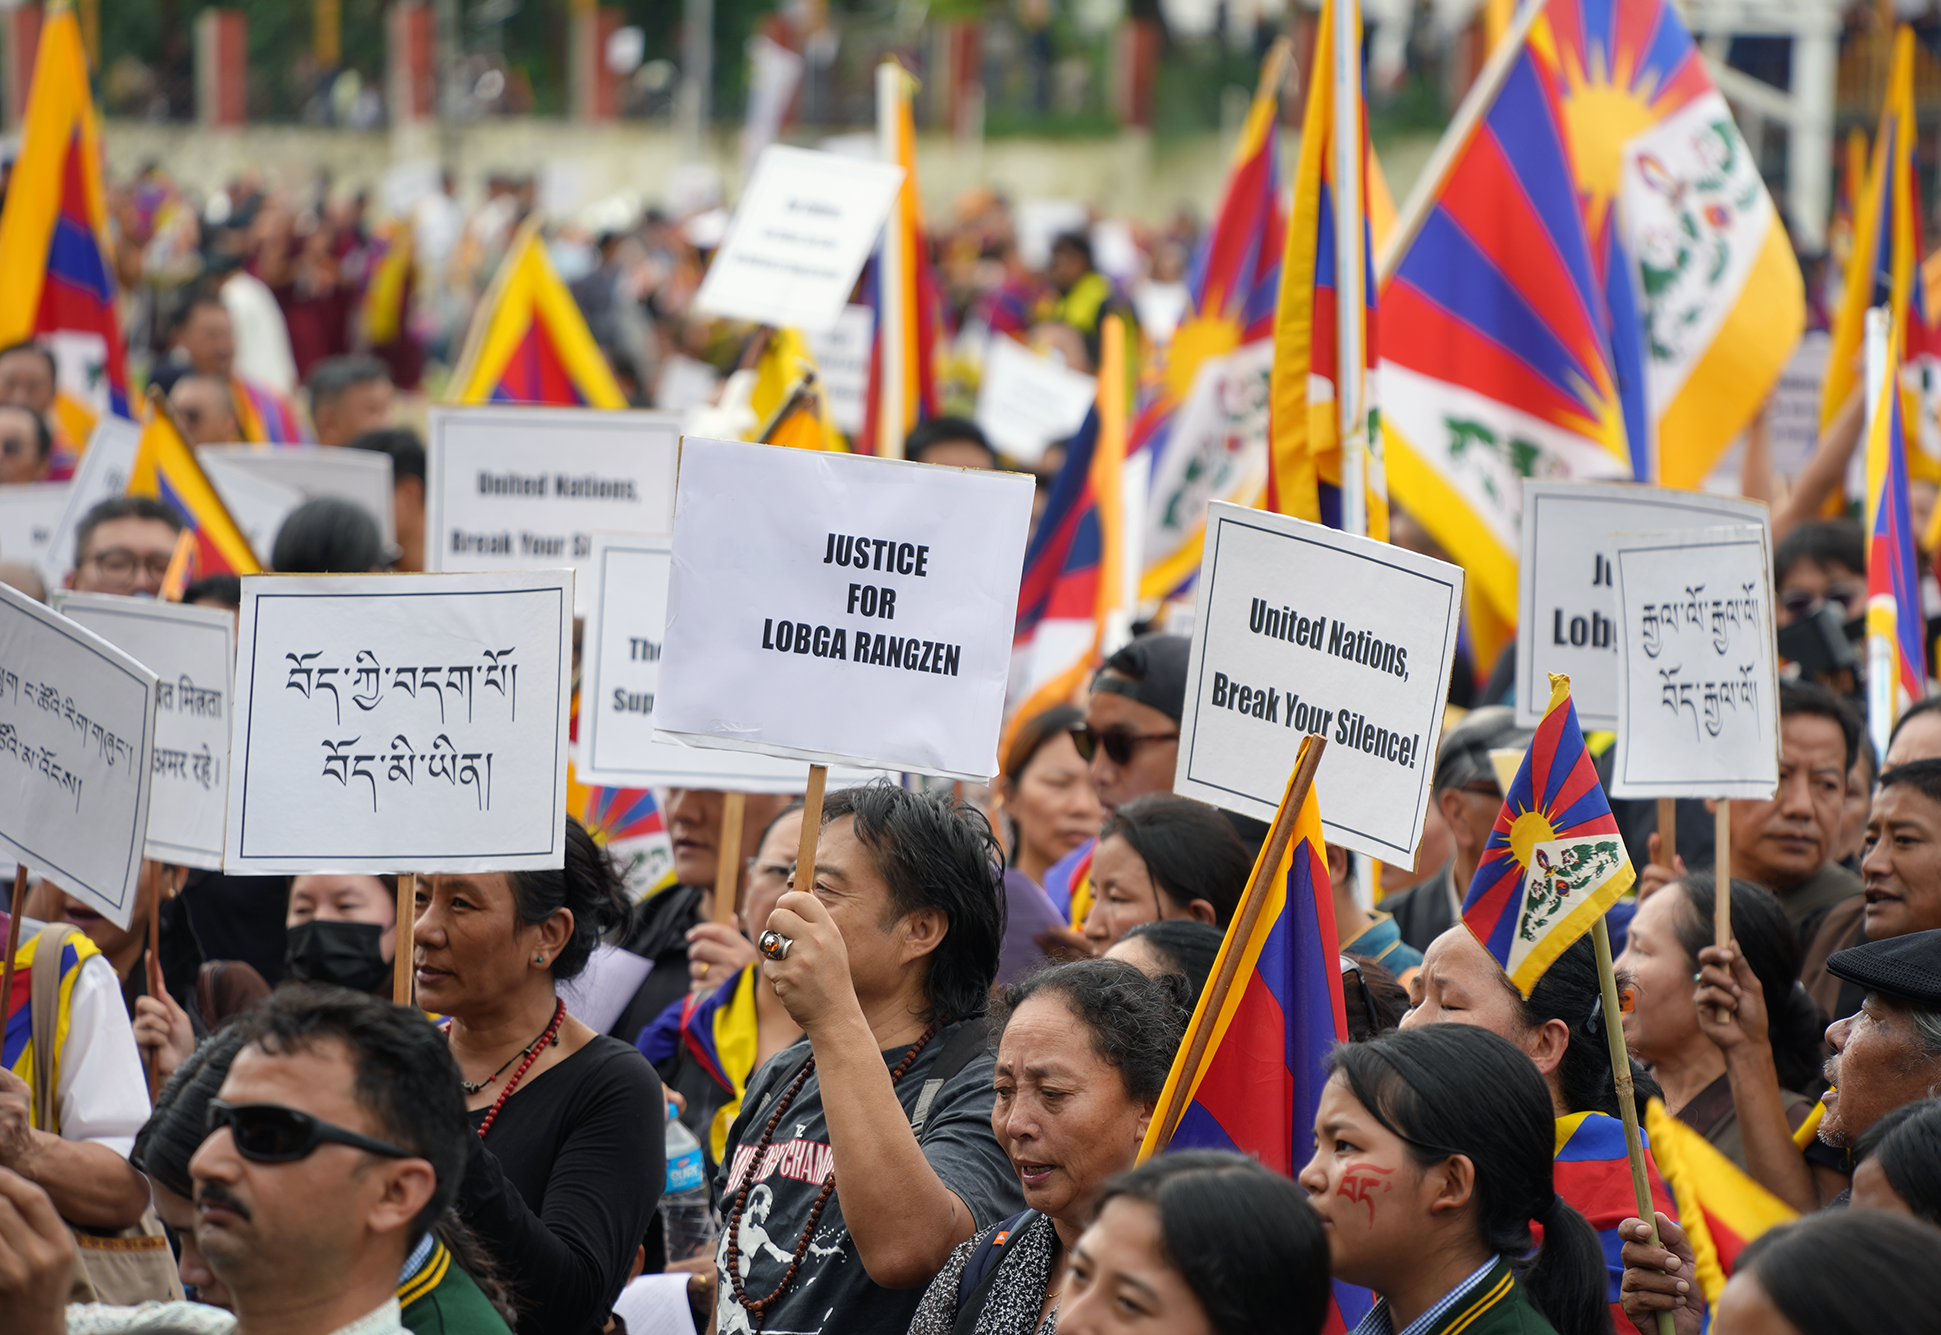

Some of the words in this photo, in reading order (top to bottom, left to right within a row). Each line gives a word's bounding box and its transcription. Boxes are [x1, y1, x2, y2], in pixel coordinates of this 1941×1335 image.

[823, 533, 930, 577] JUSTICE
[847, 583, 897, 620] FOR
[762, 618, 847, 660] LOBGA
[853, 631, 961, 677] RANGZEN
[1249, 597, 1327, 651] United
[1327, 620, 1410, 683] Nations,
[1212, 671, 1281, 724] Break
[1285, 692, 1334, 737] Your
[1335, 709, 1420, 769] Silence!
[322, 734, 493, 813] བོད་མི་ཡིན།
